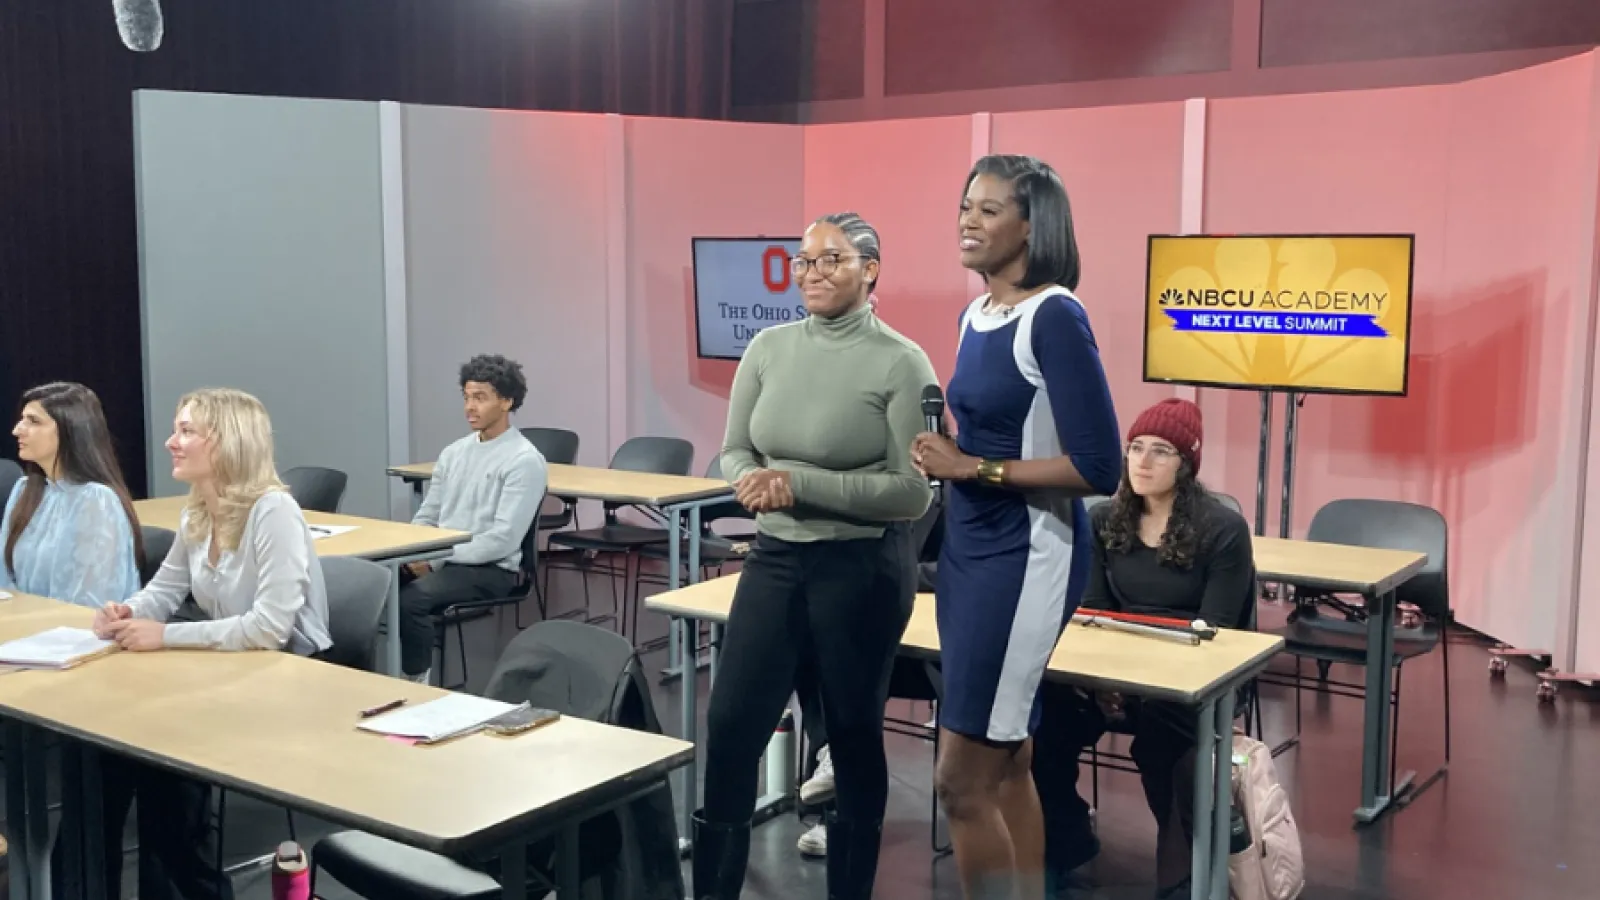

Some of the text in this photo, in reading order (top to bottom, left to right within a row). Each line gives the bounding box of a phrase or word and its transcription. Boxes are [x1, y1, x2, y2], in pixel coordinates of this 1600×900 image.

[762, 245, 791, 294] O
[1187, 289, 1388, 310] NBCU ACADEMY
[1192, 314, 1348, 331] NEXT LEVEL SUMMIT
